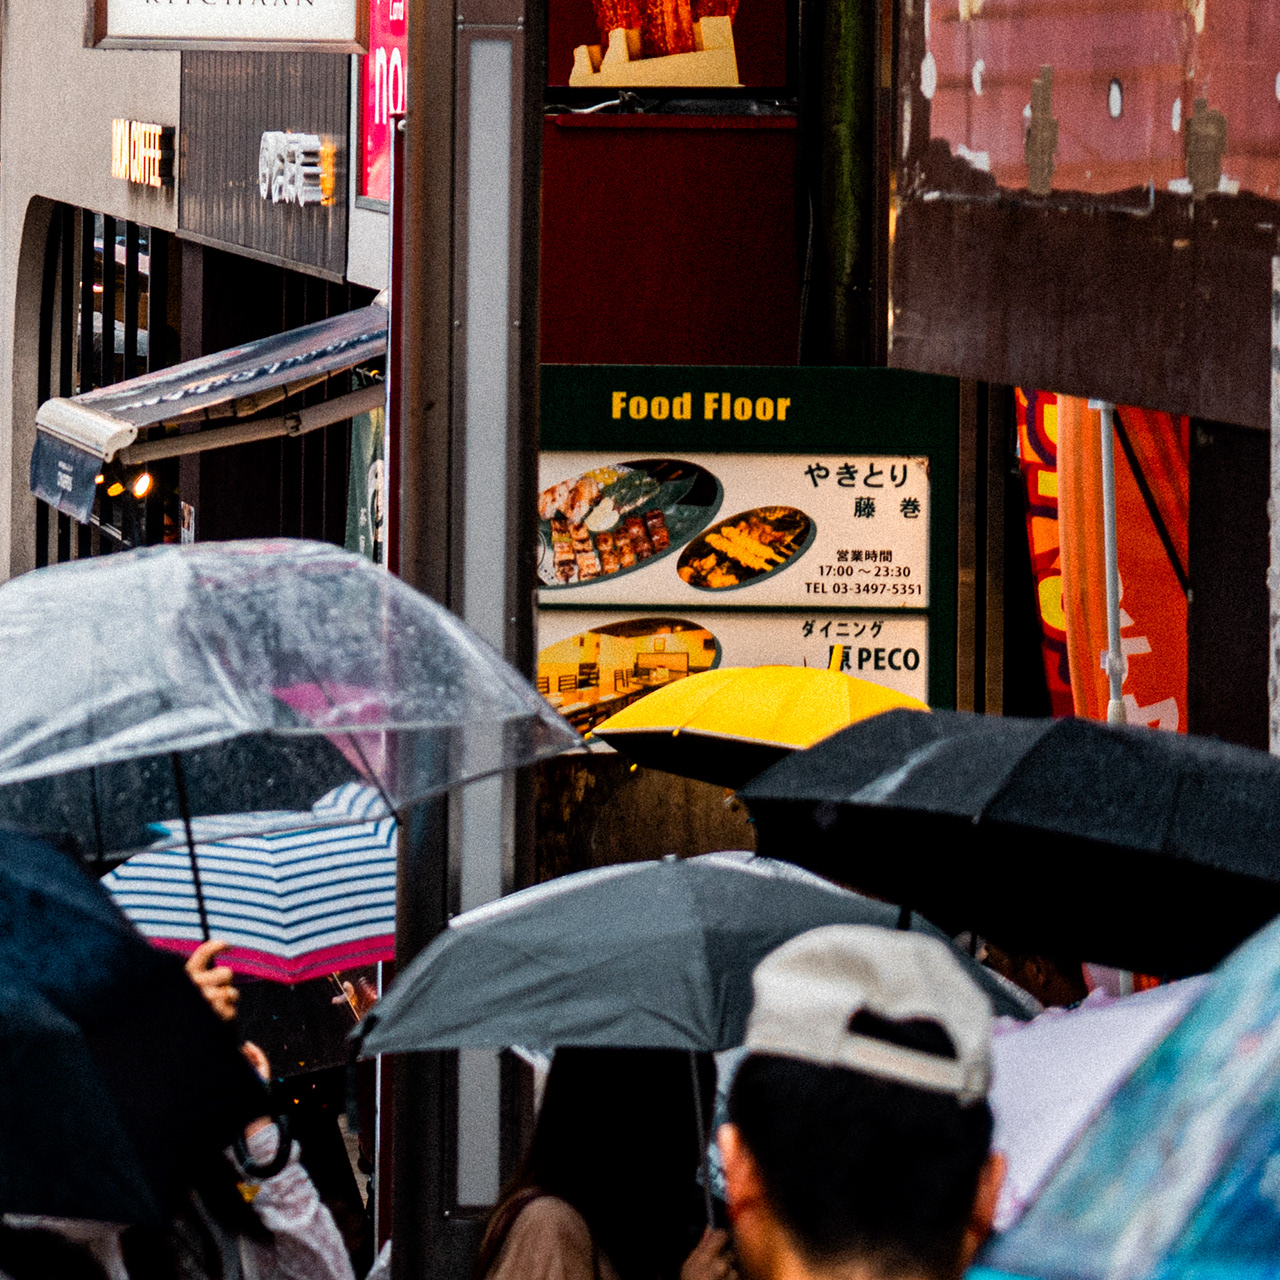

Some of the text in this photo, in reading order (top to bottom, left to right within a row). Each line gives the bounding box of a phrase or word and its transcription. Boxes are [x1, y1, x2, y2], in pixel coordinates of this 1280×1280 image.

[611, 391, 791, 421] Food Floor
[804, 462, 909, 488] やきとり
[836, 548, 893, 564] 営業時間
[819, 564, 854, 578] 17:00
[874, 565, 911, 578] 23:30
[804, 582, 923, 596] TEL 03-3497-5351
[801, 620, 884, 639] ダイニング
